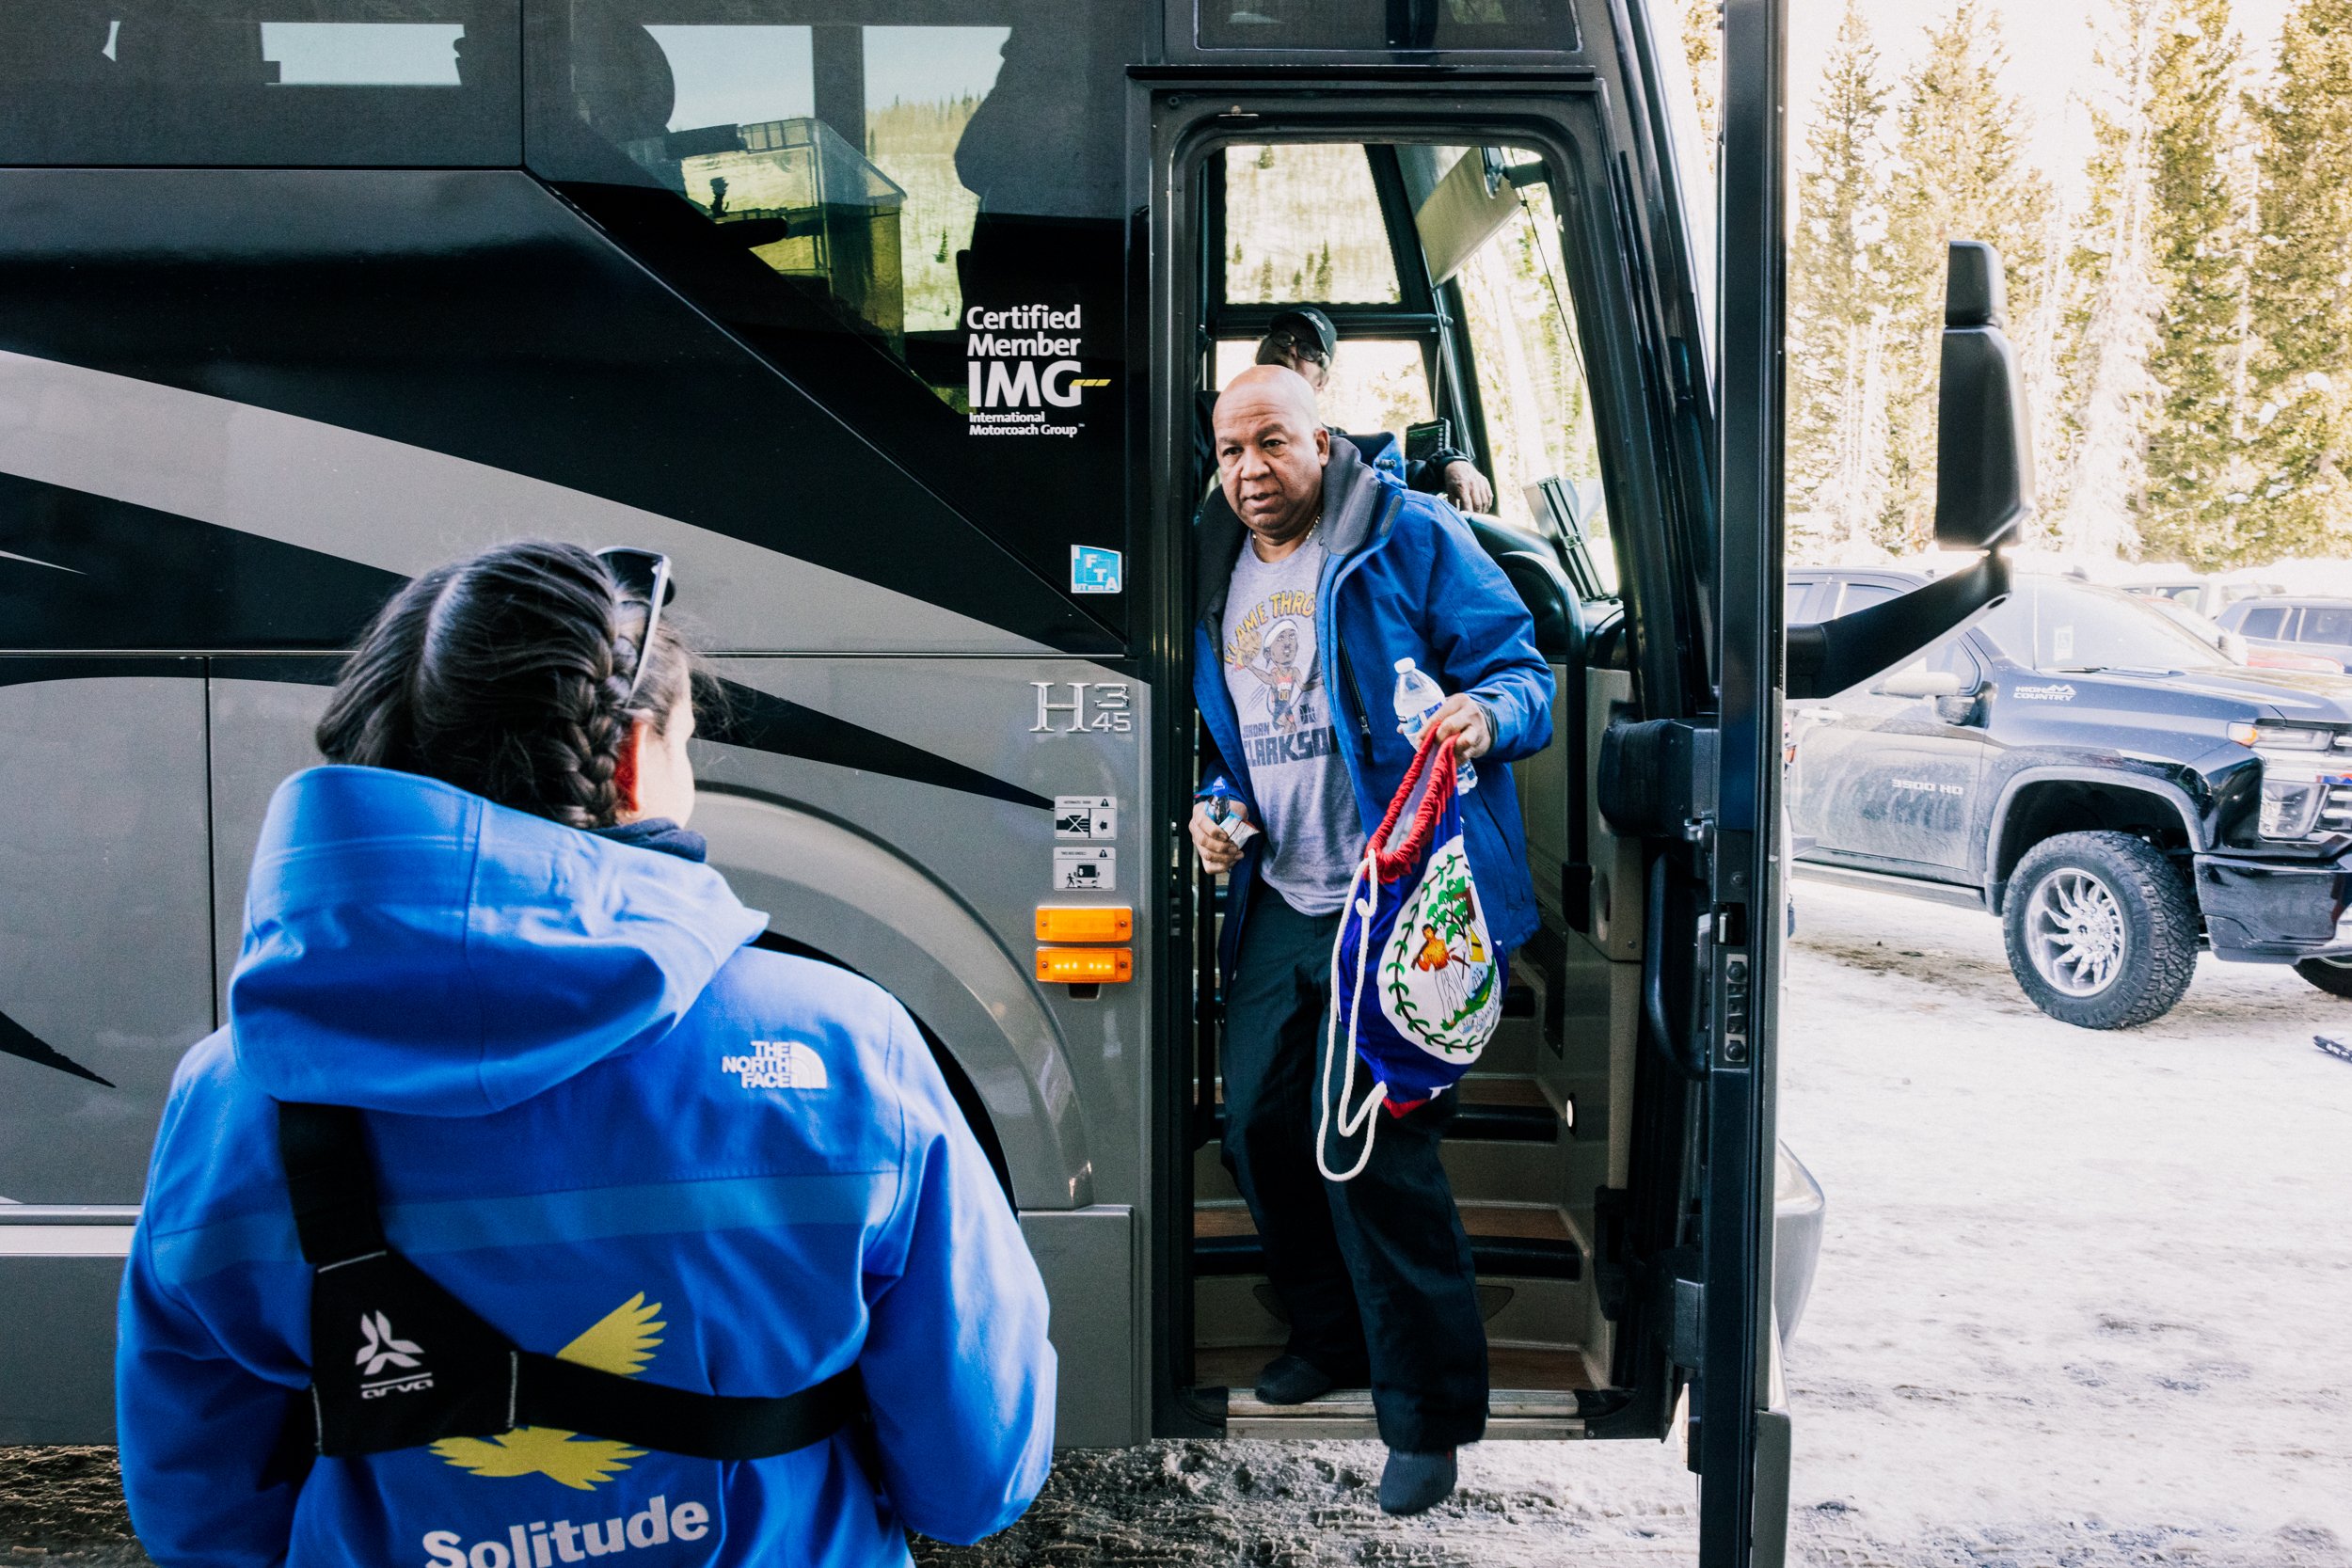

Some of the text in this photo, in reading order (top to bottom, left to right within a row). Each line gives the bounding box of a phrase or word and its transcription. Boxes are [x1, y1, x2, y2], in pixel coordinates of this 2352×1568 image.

[967, 304, 1081, 329] Certified
[967, 331, 1081, 356] Member
[968, 360, 1082, 407] IMG
[969, 411, 1045, 422] International
[969, 424, 1078, 437] Motorcoach Group
[2013, 692, 2073, 702] COUNTRY
[1029, 682, 1129, 733] H 3
[1091, 712, 1132, 733] 45
[1891, 779, 1964, 795] 3500 HD
[751, 1040, 790, 1057] THE
[722, 1055, 790, 1073] NORTH
[741, 1072, 790, 1088] FACE
[422, 1495, 709, 1568] Solitude
